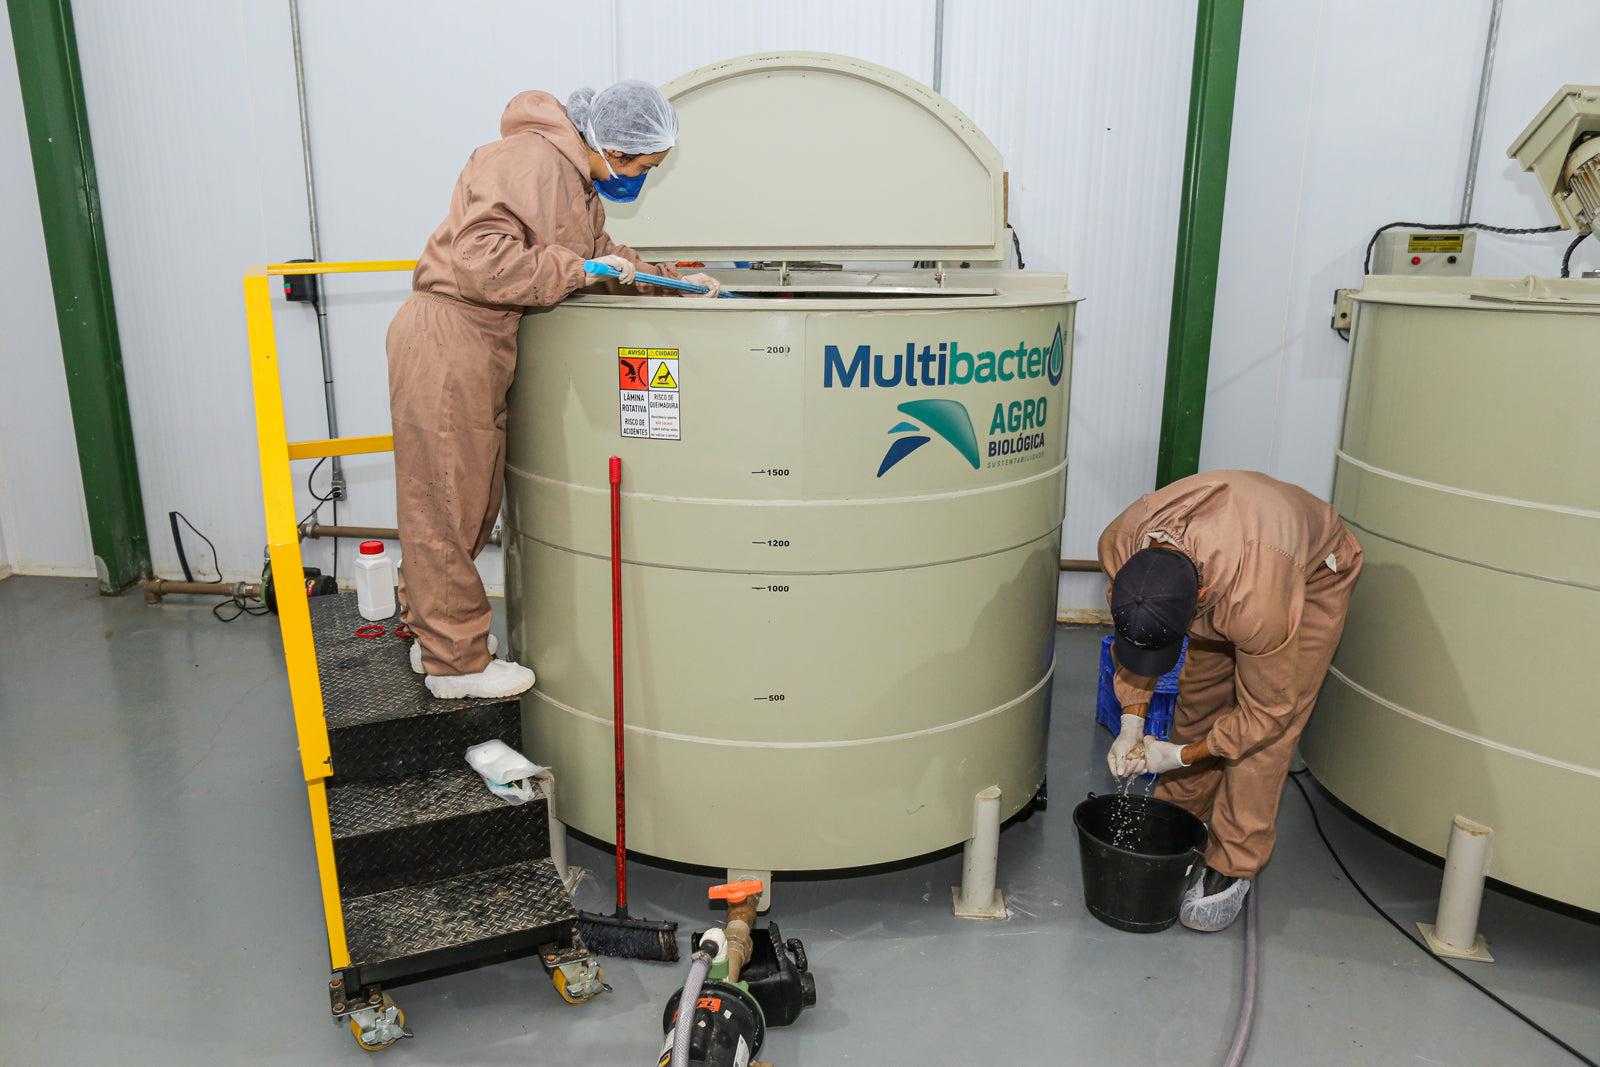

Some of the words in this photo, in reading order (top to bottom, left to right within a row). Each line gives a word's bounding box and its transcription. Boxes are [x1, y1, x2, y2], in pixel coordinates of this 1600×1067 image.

[766, 346, 790, 354] 2000
[623, 392, 645, 402] LÂMINA
[653, 393, 667, 401] RISCO
[622, 403, 647, 413] ROTATIVA
[649, 401, 679, 409] QUEIMADURA
[989, 396, 1047, 435] AGRO
[624, 418, 638, 426] RISCO
[639, 418, 645, 426] DE
[623, 428, 648, 436] ACIDENTES
[988, 432, 1045, 457] BIOLÓGICA
